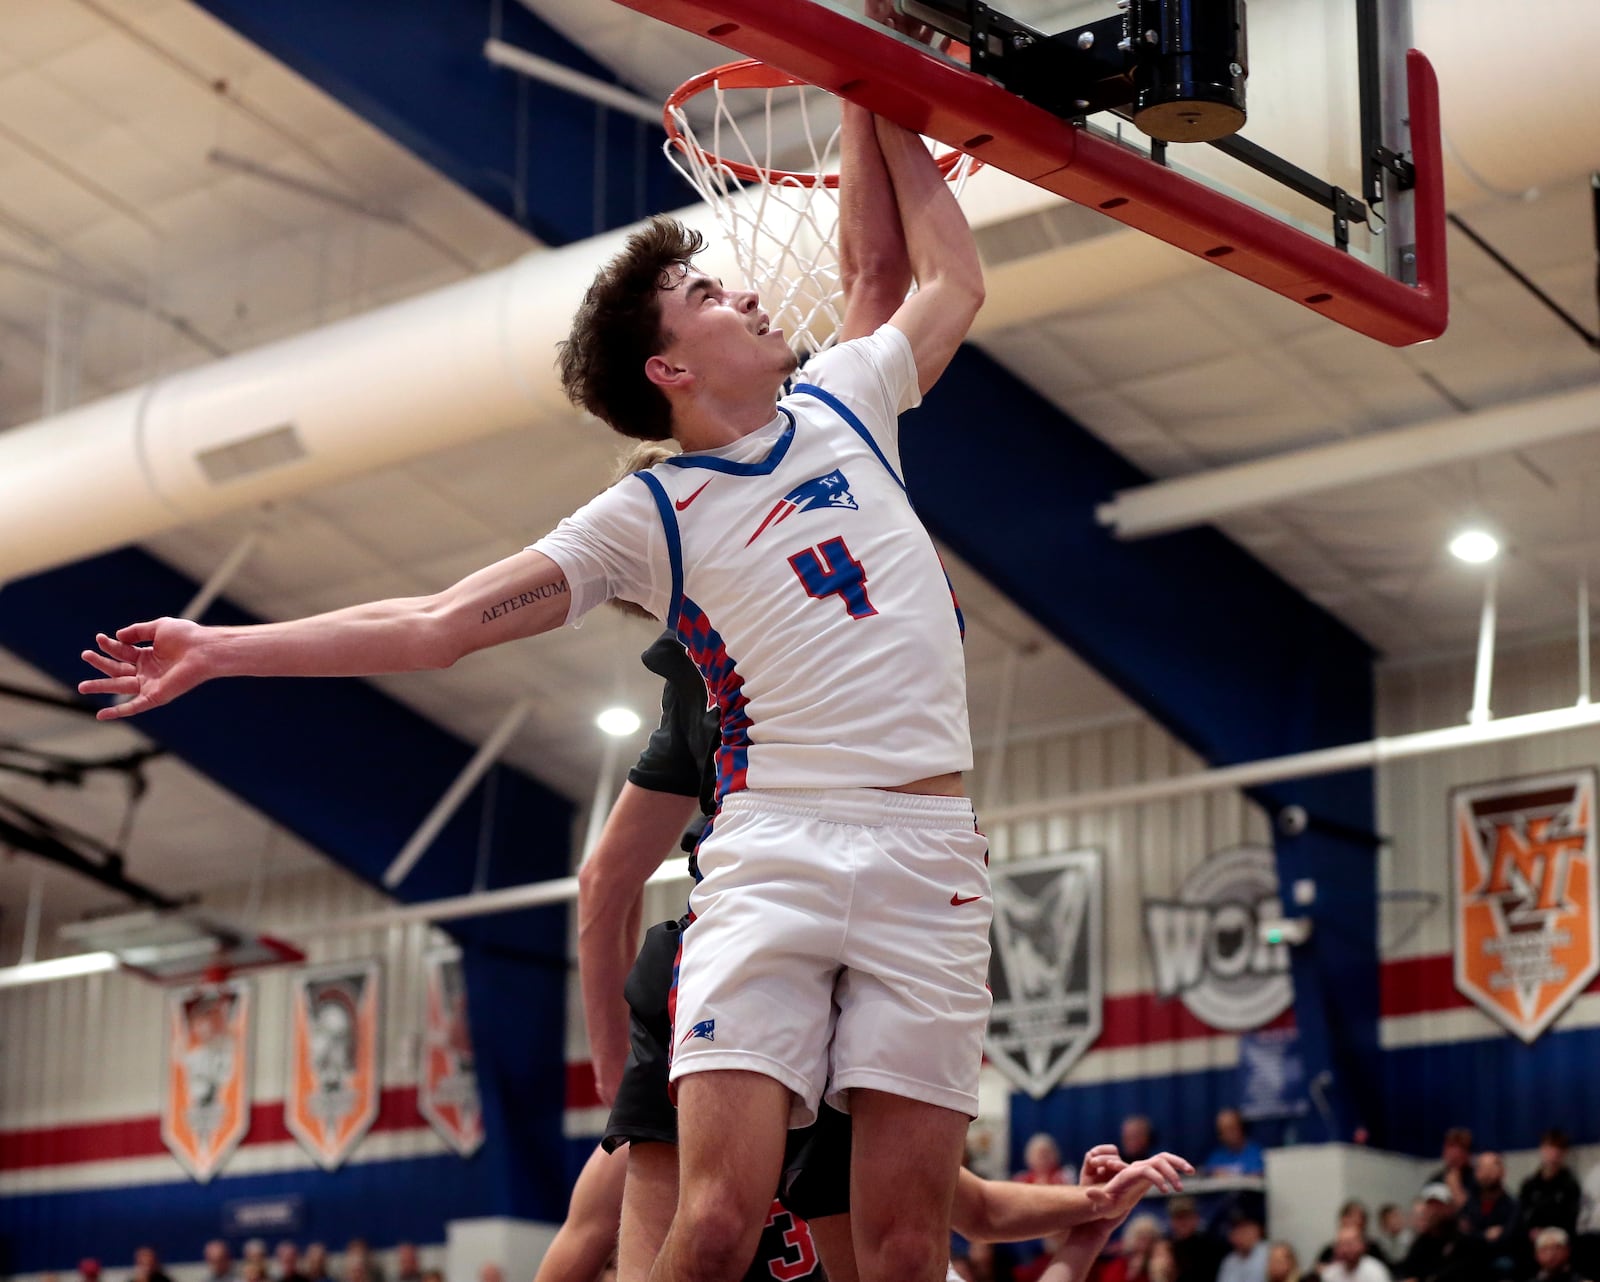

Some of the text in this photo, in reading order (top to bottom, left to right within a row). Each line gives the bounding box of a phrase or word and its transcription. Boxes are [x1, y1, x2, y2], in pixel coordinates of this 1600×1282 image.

[818, 475, 840, 489] TV
[481, 579, 568, 624] AETERNUM
[786, 535, 880, 621] 4
[764, 1197, 819, 1282] 3
